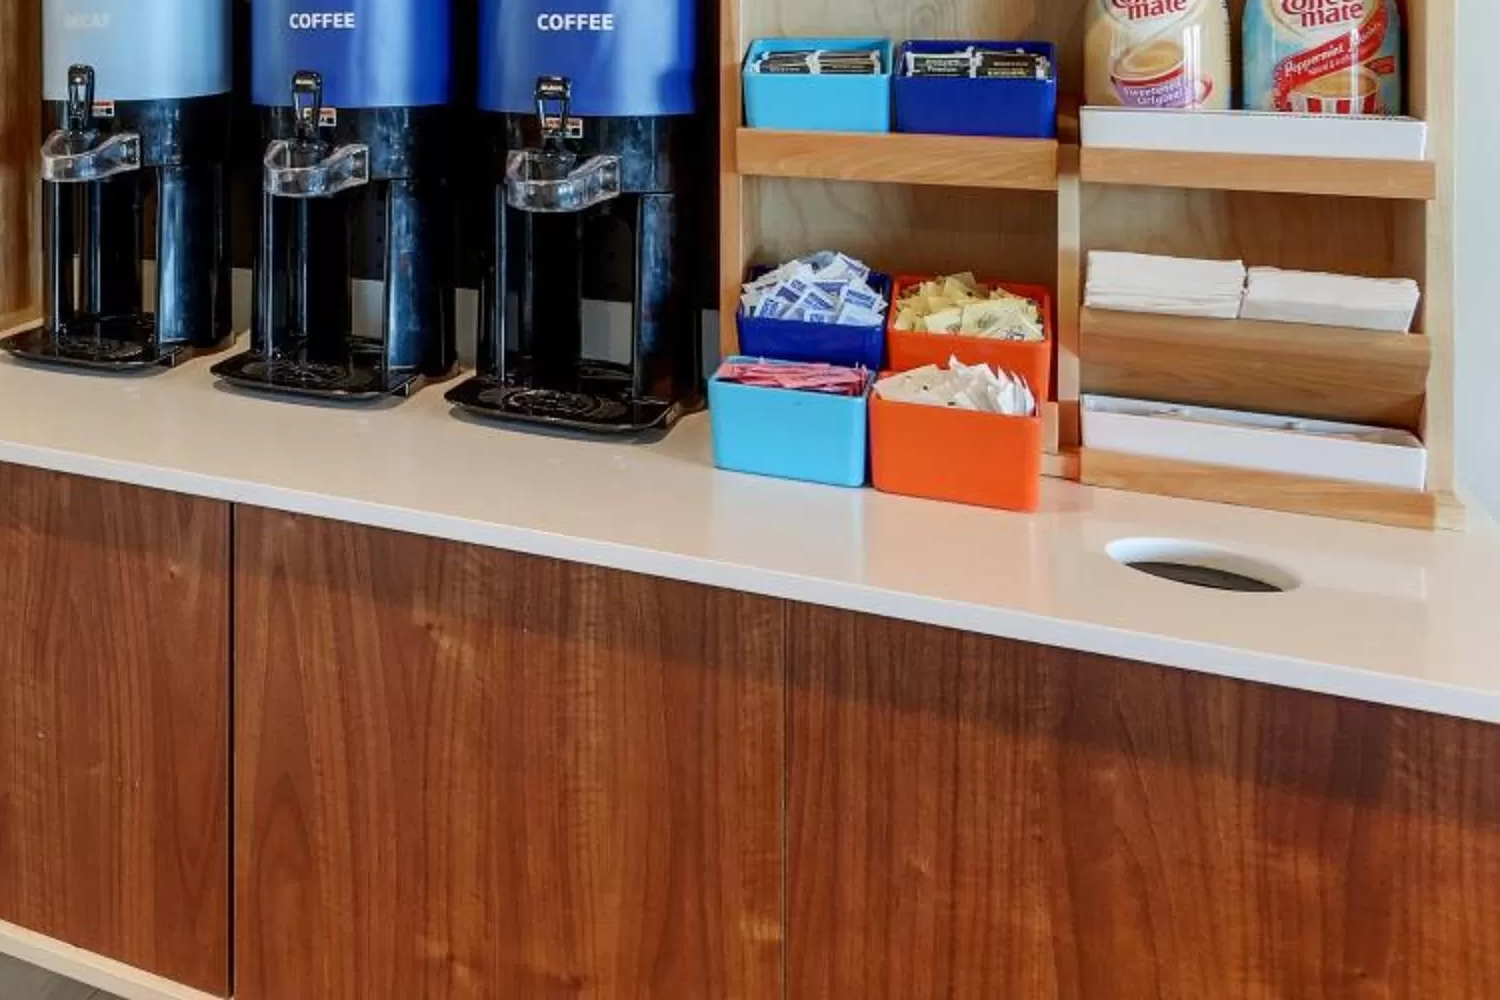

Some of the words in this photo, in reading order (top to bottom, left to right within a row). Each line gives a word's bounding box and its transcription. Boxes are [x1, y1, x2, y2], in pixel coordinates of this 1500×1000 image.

[288, 12, 357, 30] COFFEE
[536, 13, 615, 31] COFFEE
[1301, 1, 1365, 28] mate
